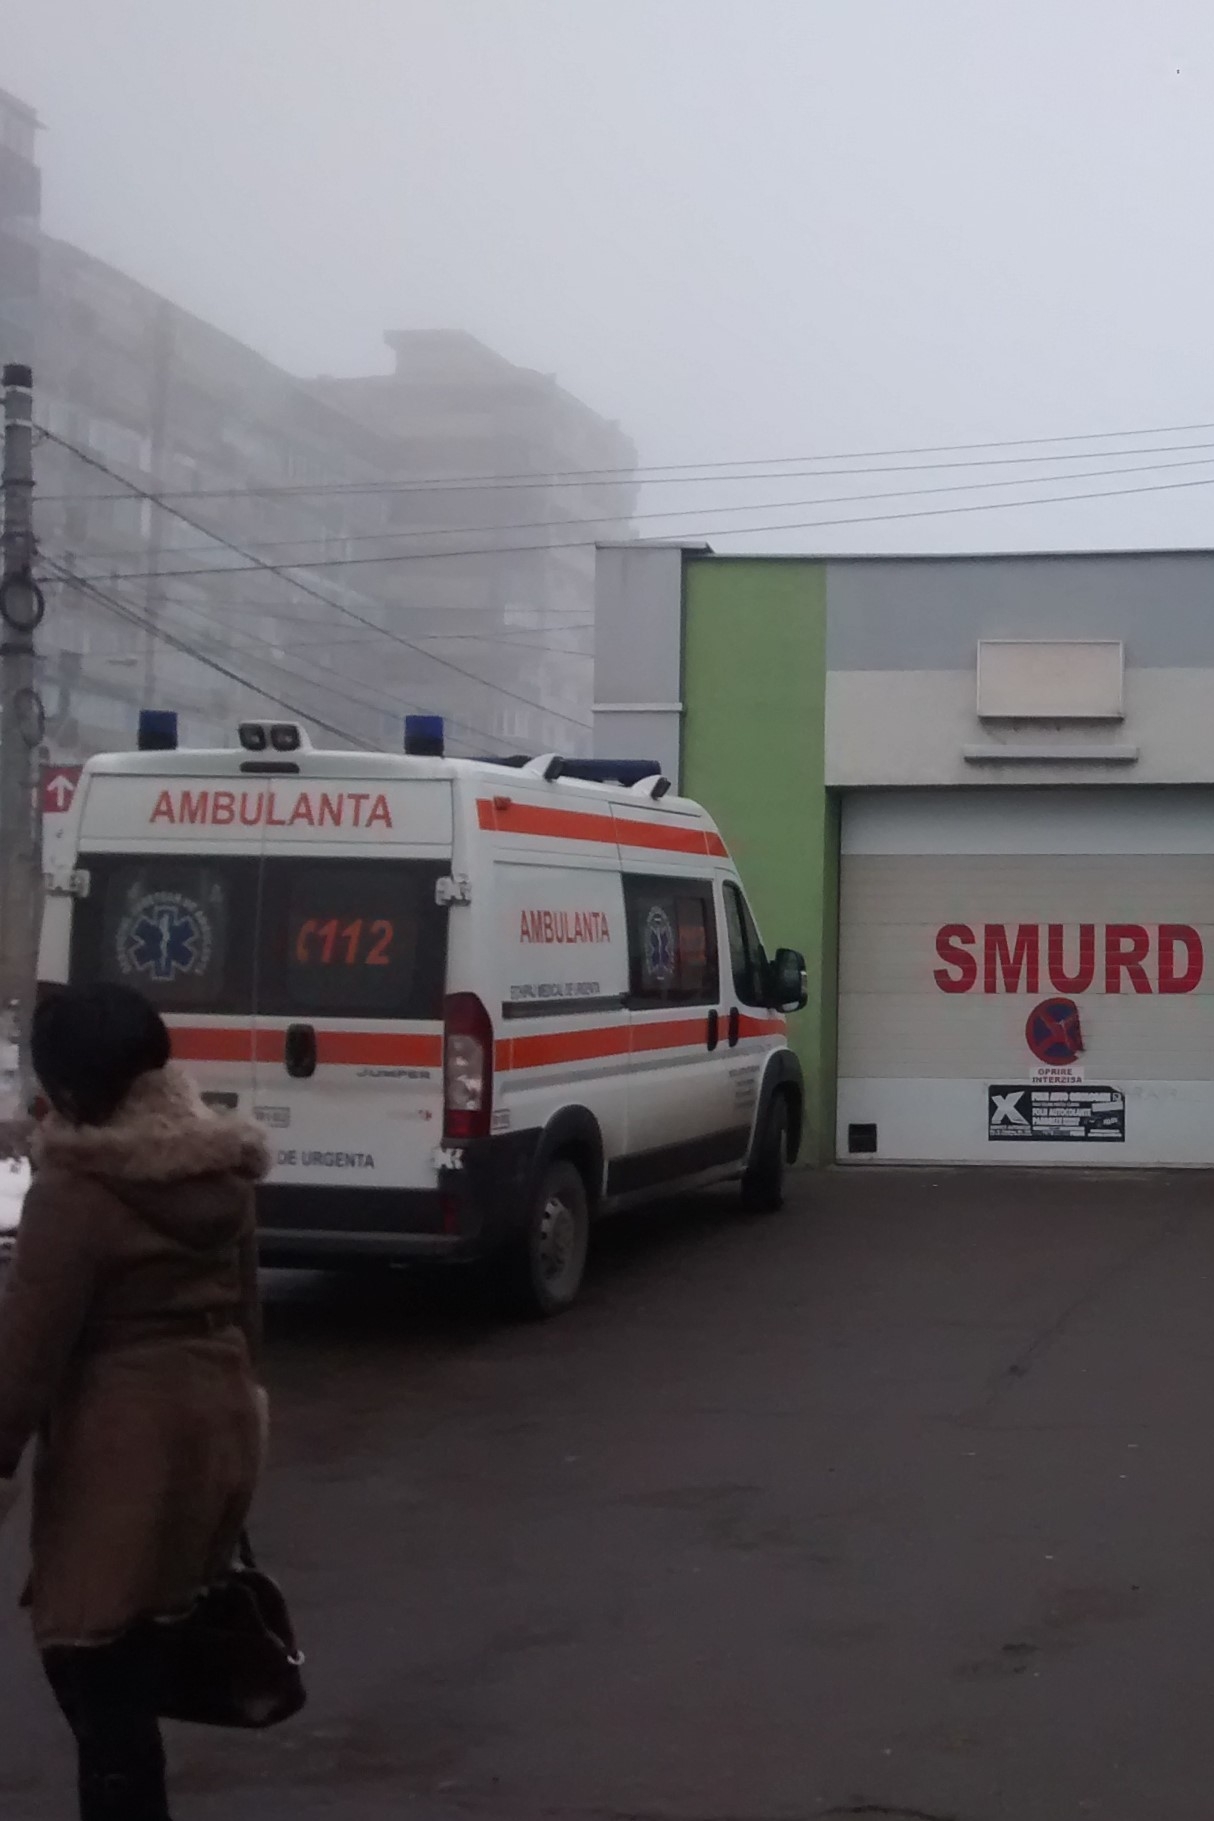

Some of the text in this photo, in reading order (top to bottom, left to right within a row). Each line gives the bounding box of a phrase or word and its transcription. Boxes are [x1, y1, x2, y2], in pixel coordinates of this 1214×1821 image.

[149, 790, 393, 829] AMBULANTA
[519, 910, 611, 944] AMBULANTA
[933, 922, 1204, 995] SMURD
[1032, 1076, 1082, 1084] INTERZISA
[1037, 1068, 1073, 1076] OPRIRE
[278, 1150, 375, 1169] DE URGENTA
